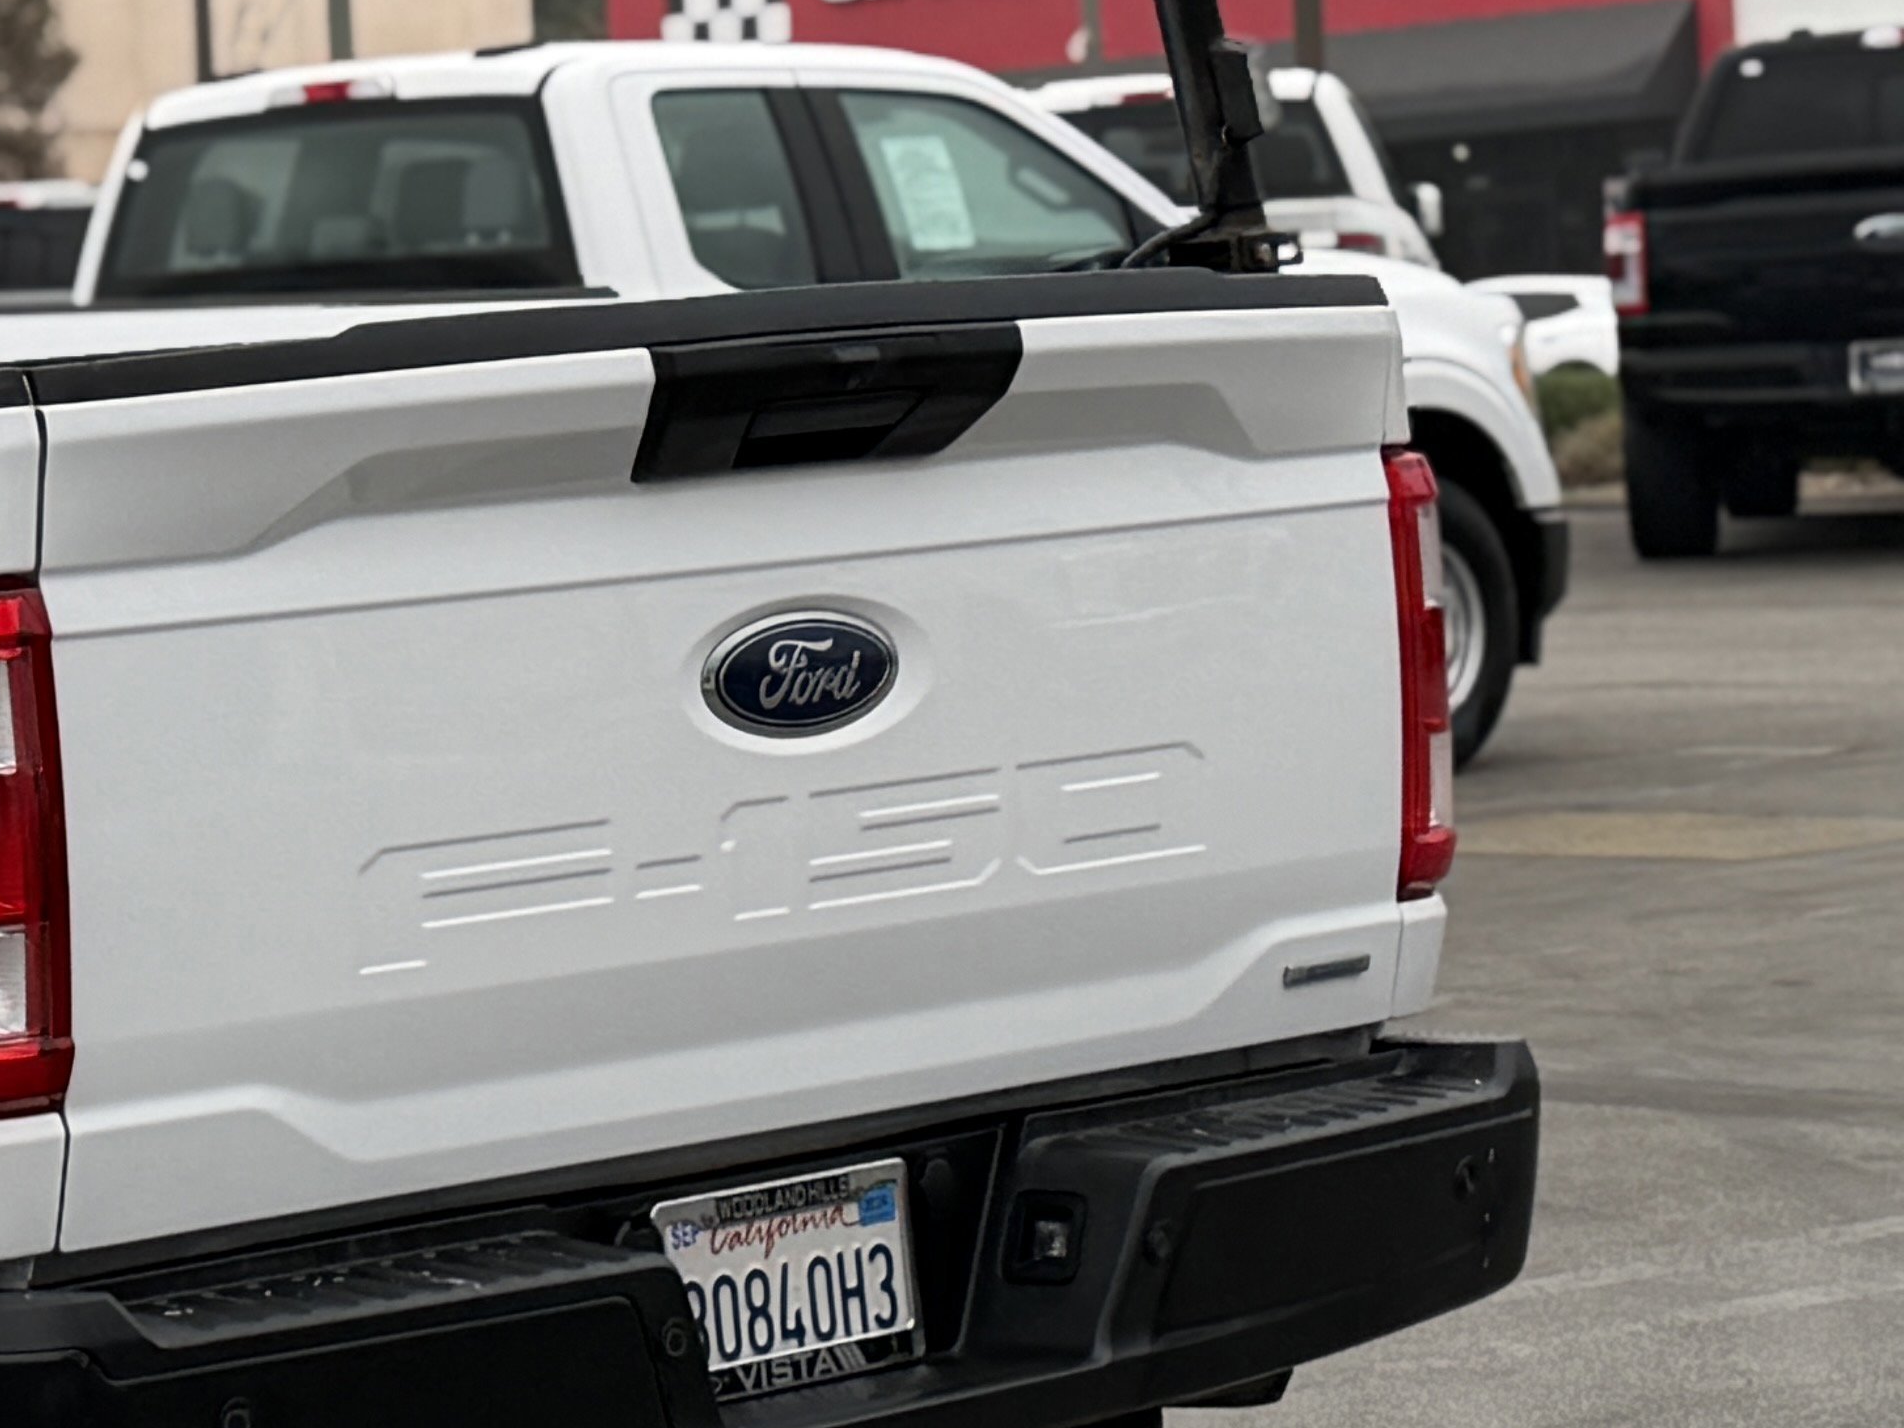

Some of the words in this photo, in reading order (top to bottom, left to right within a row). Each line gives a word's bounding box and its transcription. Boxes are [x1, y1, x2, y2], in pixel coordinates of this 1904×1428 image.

[759, 635, 862, 710] Ford
[358, 740, 1206, 974] F-150
[717, 1186, 805, 1220] WOODLAND
[708, 1204, 859, 1259] California
[734, 1347, 838, 1393] VISTA
